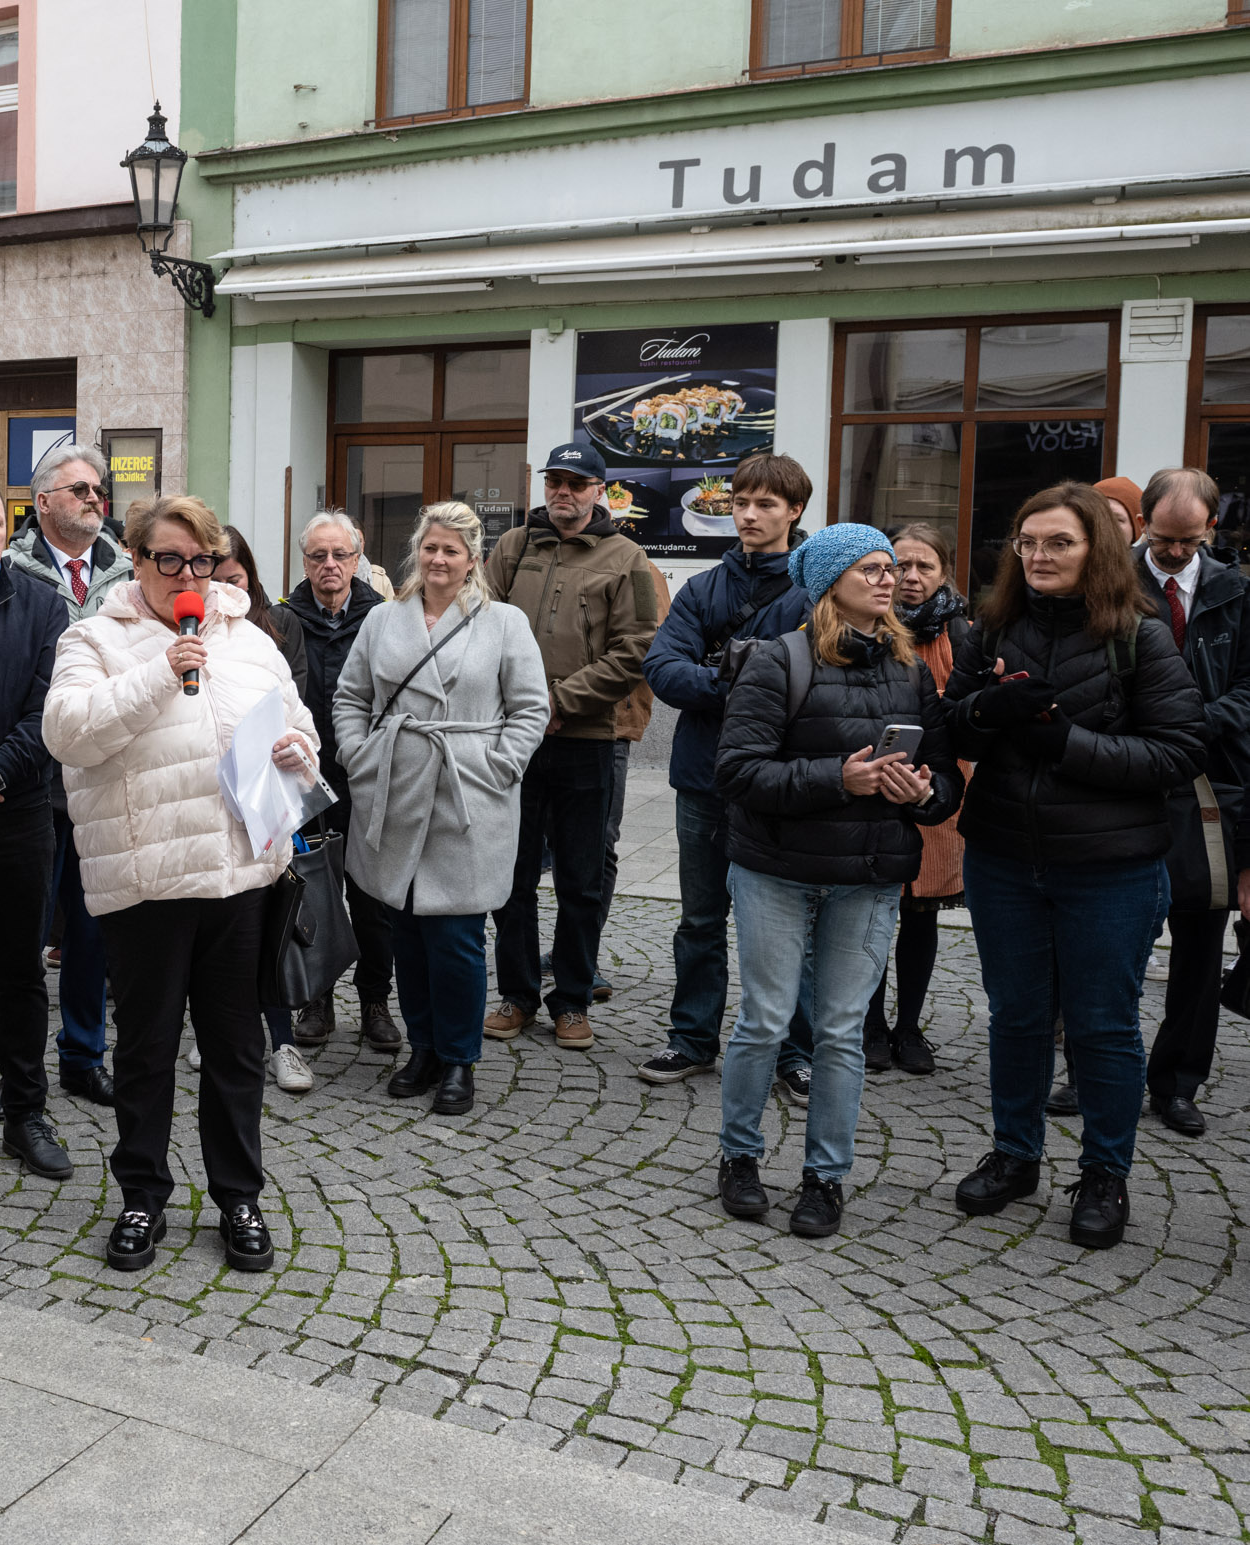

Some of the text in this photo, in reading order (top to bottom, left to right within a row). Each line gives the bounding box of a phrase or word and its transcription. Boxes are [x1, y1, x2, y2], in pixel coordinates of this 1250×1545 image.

[659, 142, 1016, 209] Tudam
[639, 333, 710, 362] Tudam
[110, 456, 154, 471] INZERCE
[477, 504, 510, 513] Tudam
